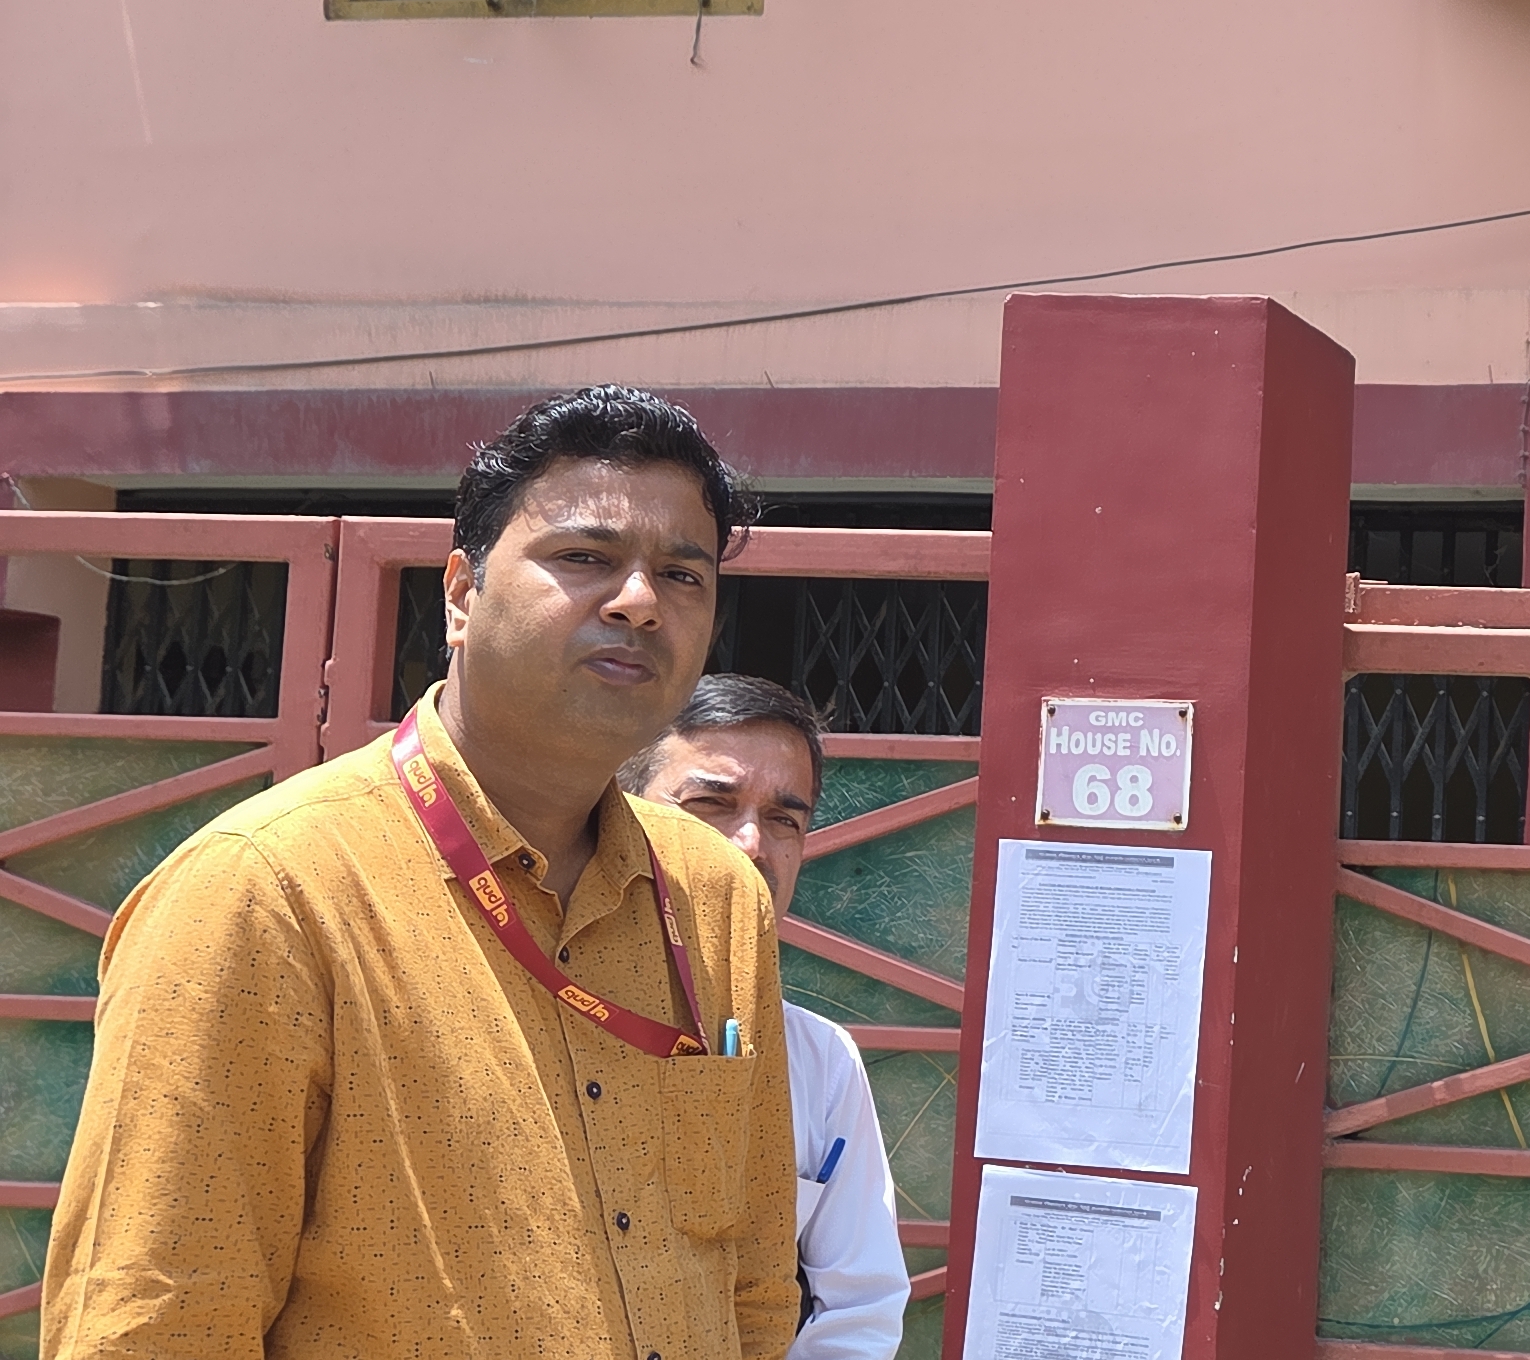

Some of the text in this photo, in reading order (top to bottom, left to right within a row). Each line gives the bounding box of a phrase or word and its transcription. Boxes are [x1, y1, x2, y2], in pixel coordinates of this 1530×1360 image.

[1089, 710, 1144, 727] GMC
[1050, 726, 1131, 756] HOUSE
[1072, 763, 1153, 817] 68
